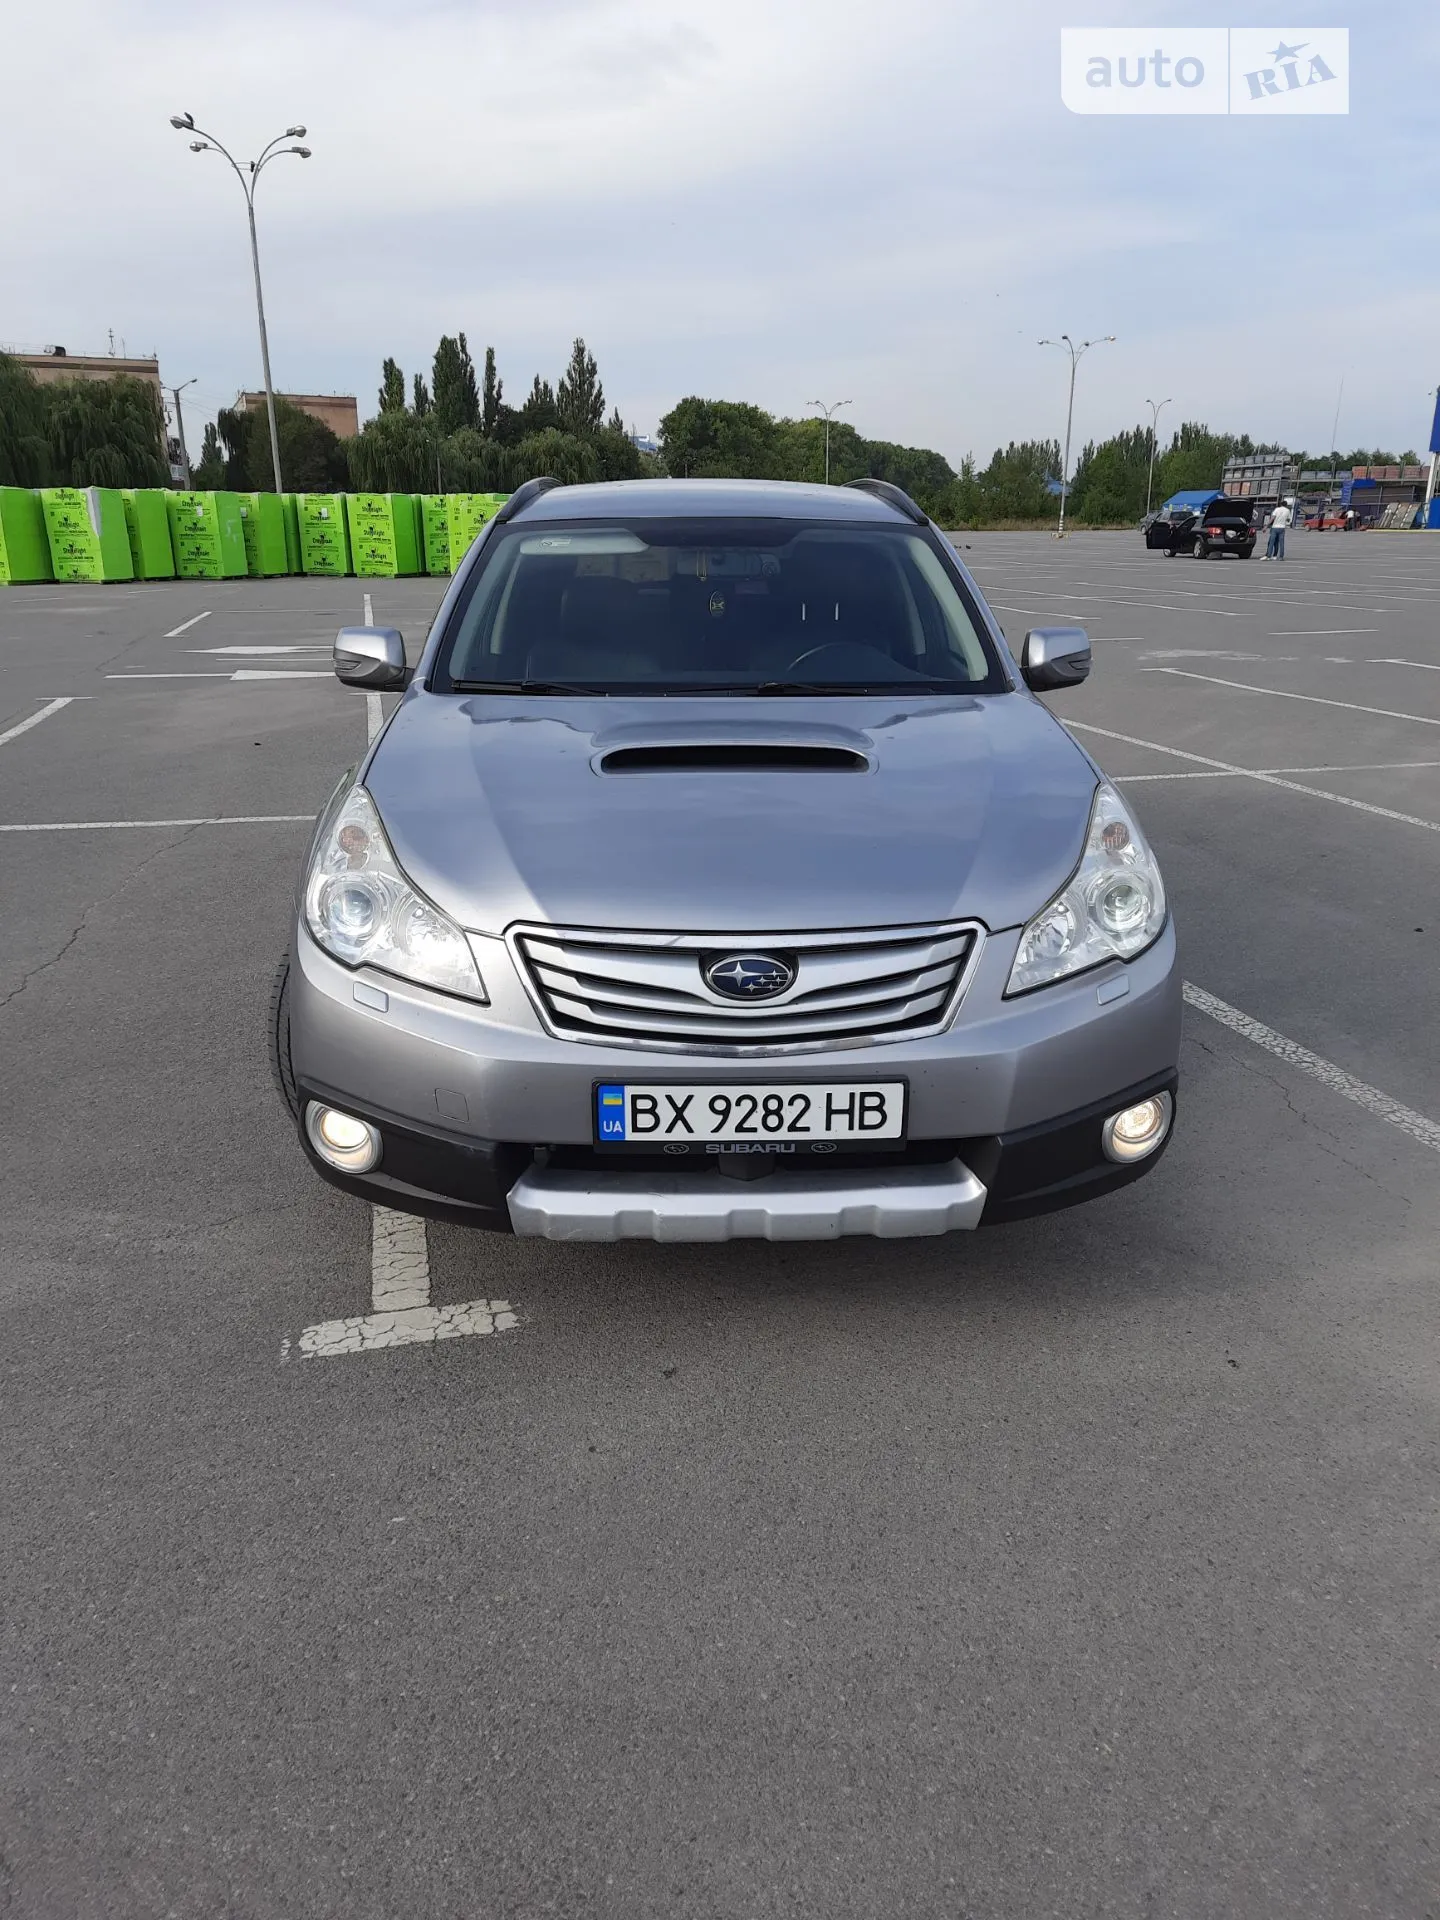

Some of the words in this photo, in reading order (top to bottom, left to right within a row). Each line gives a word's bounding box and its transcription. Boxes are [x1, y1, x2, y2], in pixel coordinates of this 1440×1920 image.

[631, 1094, 695, 1133] BX
[708, 1093, 811, 1133] 9282
[825, 1091, 888, 1132] HB
[603, 1120, 623, 1133] UA
[705, 1143, 796, 1154] SUBARU
